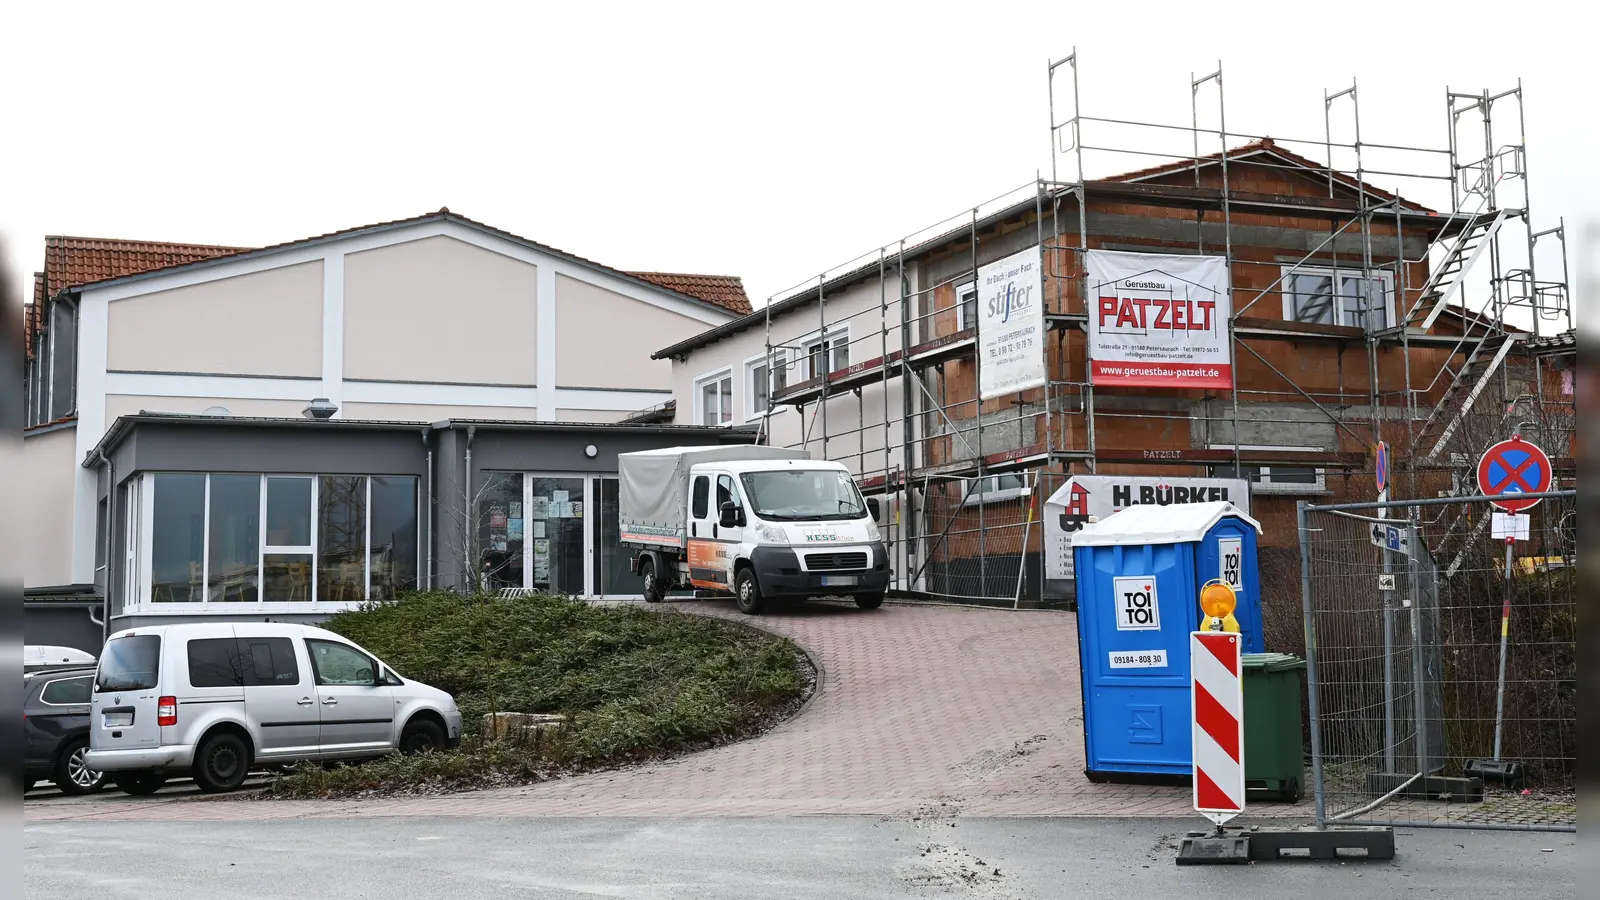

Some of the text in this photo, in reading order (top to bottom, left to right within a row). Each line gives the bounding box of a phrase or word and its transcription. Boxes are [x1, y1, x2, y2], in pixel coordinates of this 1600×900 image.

[1021, 262, 1032, 273] Fach
[1125, 279, 1166, 290] Gerüstbau
[987, 280, 1033, 324] stifter
[1098, 296, 1216, 331] PATZELT
[1125, 351, 1193, 360] info@geruestbau-patzelt.de
[1100, 366, 1219, 379] www.geruestbau-patzelt.de
[1143, 450, 1181, 459] PATZELT
[715, 550, 727, 558] HESS
[1225, 553, 1240, 570] TOI
[1224, 569, 1239, 586] TOI
[1124, 592, 1152, 608] TOI
[1125, 608, 1154, 624] TOI
[1114, 656, 1134, 664] 09184
[1138, 655, 1152, 664] 808
[1153, 655, 1162, 663] 30
